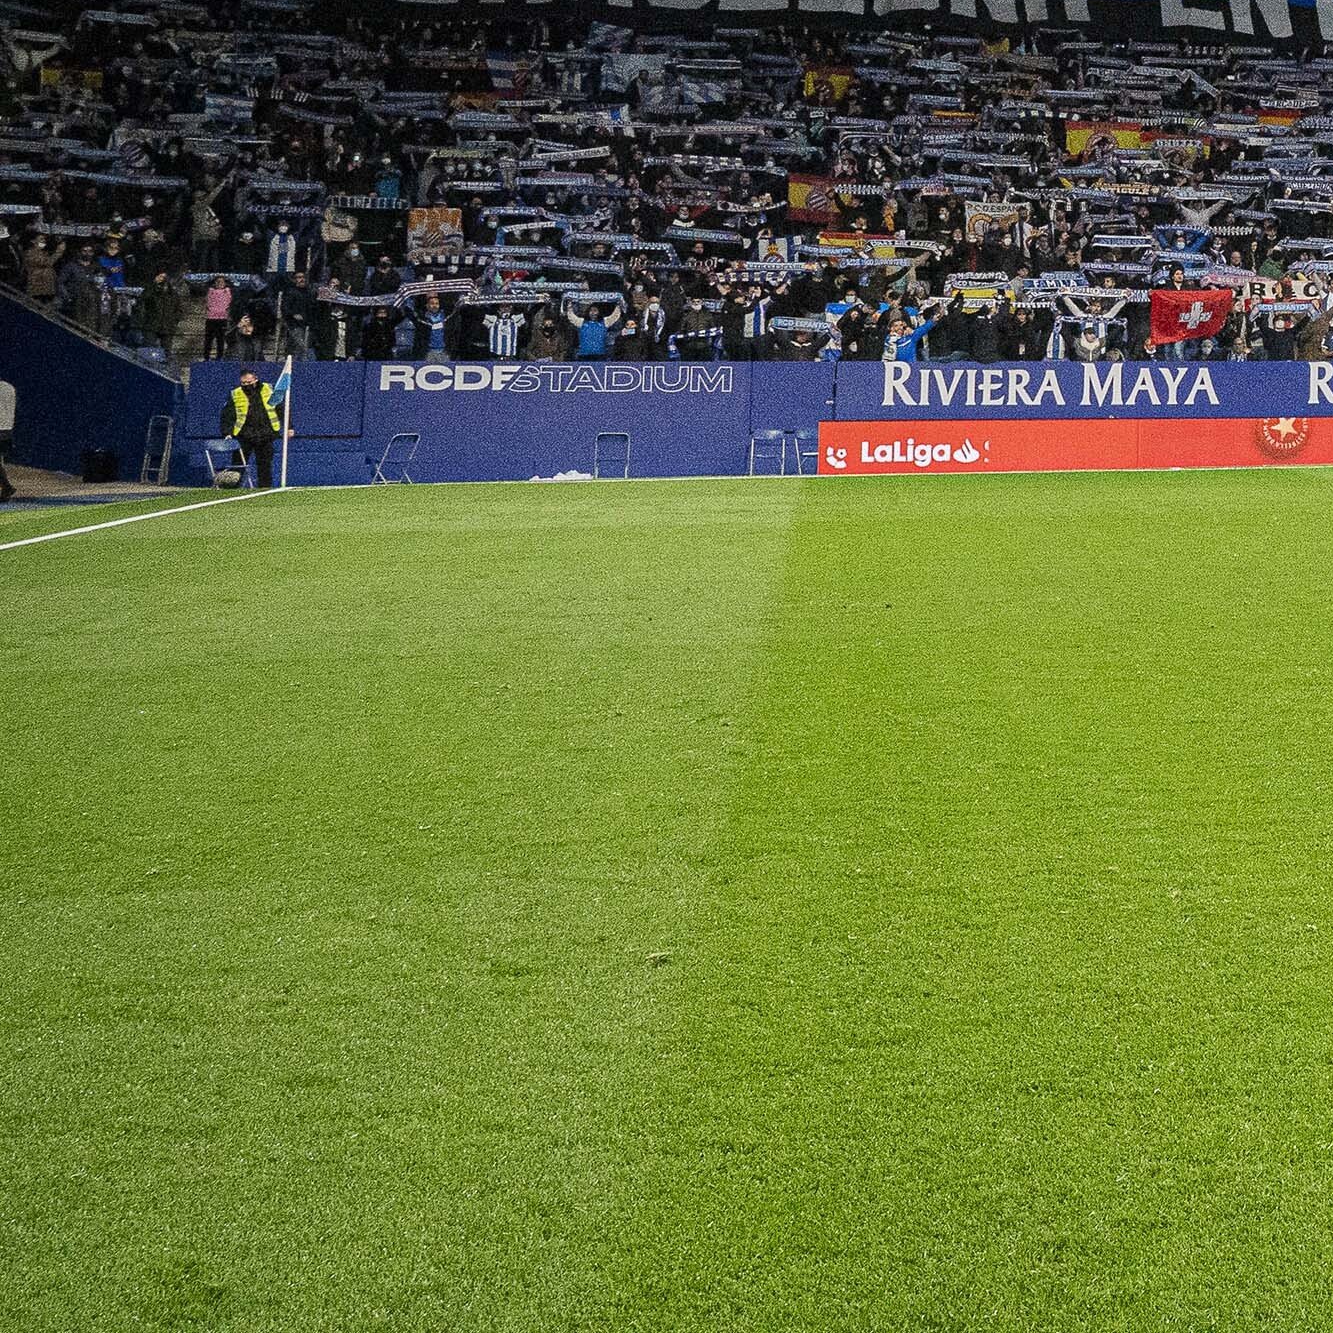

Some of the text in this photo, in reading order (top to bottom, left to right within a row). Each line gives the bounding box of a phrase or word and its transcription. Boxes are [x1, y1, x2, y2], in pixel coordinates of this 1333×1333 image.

[510, 365, 732, 394] STADIUM
[881, 361, 1220, 407] RIVIERA MAYA
[860, 438, 951, 466] LaLiga
